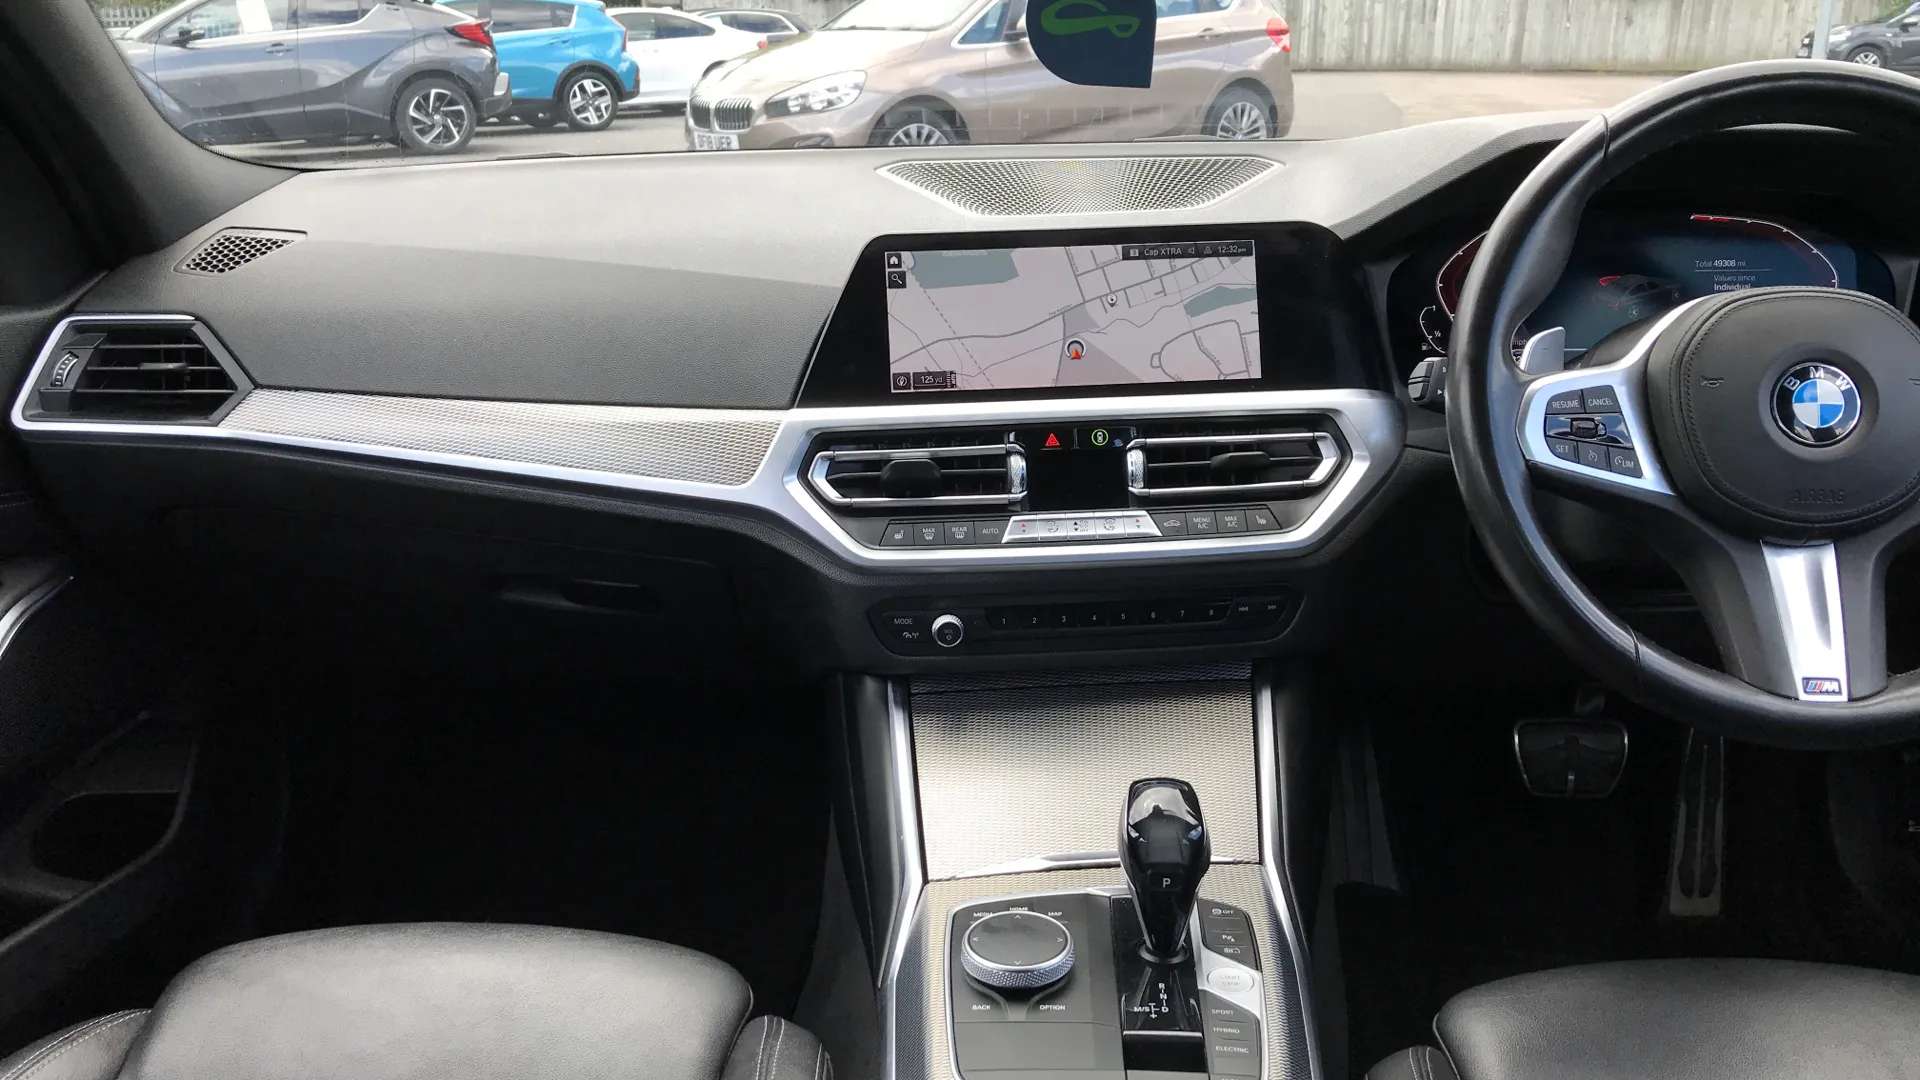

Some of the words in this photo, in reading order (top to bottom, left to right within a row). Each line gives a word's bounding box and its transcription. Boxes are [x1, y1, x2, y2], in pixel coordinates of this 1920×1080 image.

[1144, 248, 1159, 257] Cap
[1712, 259, 1736, 267] 49308
[1713, 282, 1751, 291] Individual
[920, 375, 934, 384] 125
[1783, 365, 1852, 392] BMW
[1551, 399, 1580, 409] RESUME
[1587, 397, 1614, 407] CANCEL
[982, 527, 999, 535] AUTO
[893, 617, 913, 625] MODE
[1162, 877, 1171, 889] P
[1215, 1045, 1250, 1055] ELECTRIC
